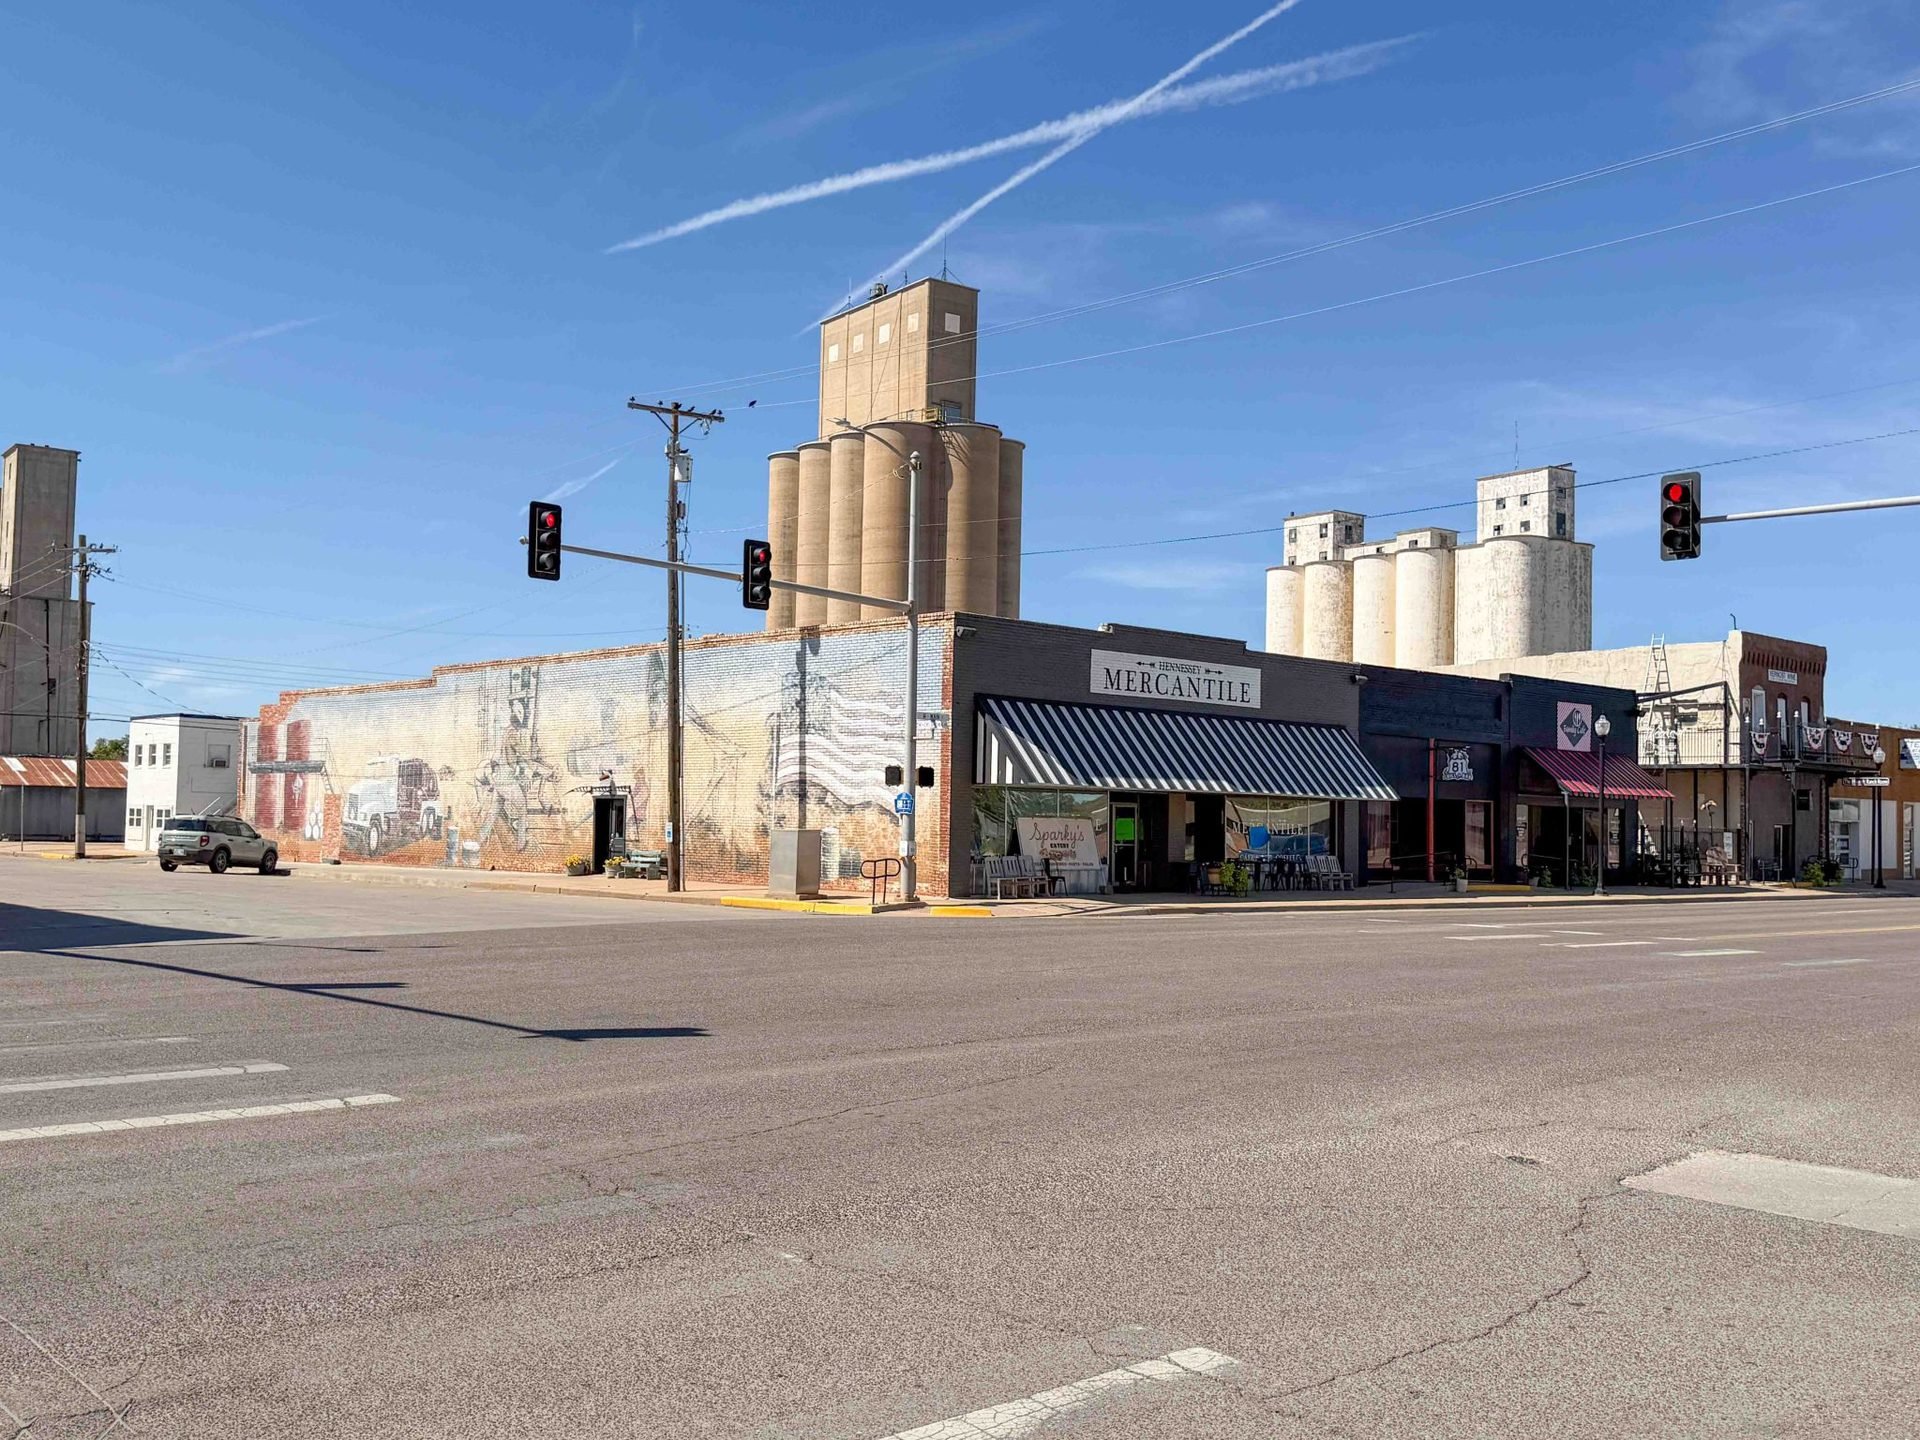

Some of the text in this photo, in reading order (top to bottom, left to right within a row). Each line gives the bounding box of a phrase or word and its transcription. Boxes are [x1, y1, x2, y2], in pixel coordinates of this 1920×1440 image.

[1158, 661, 1202, 675] HENNESSEY
[1103, 667, 1251, 703] MERCANTILE
[1452, 761, 1464, 773] 81
[1029, 822, 1085, 849] Sparky's
